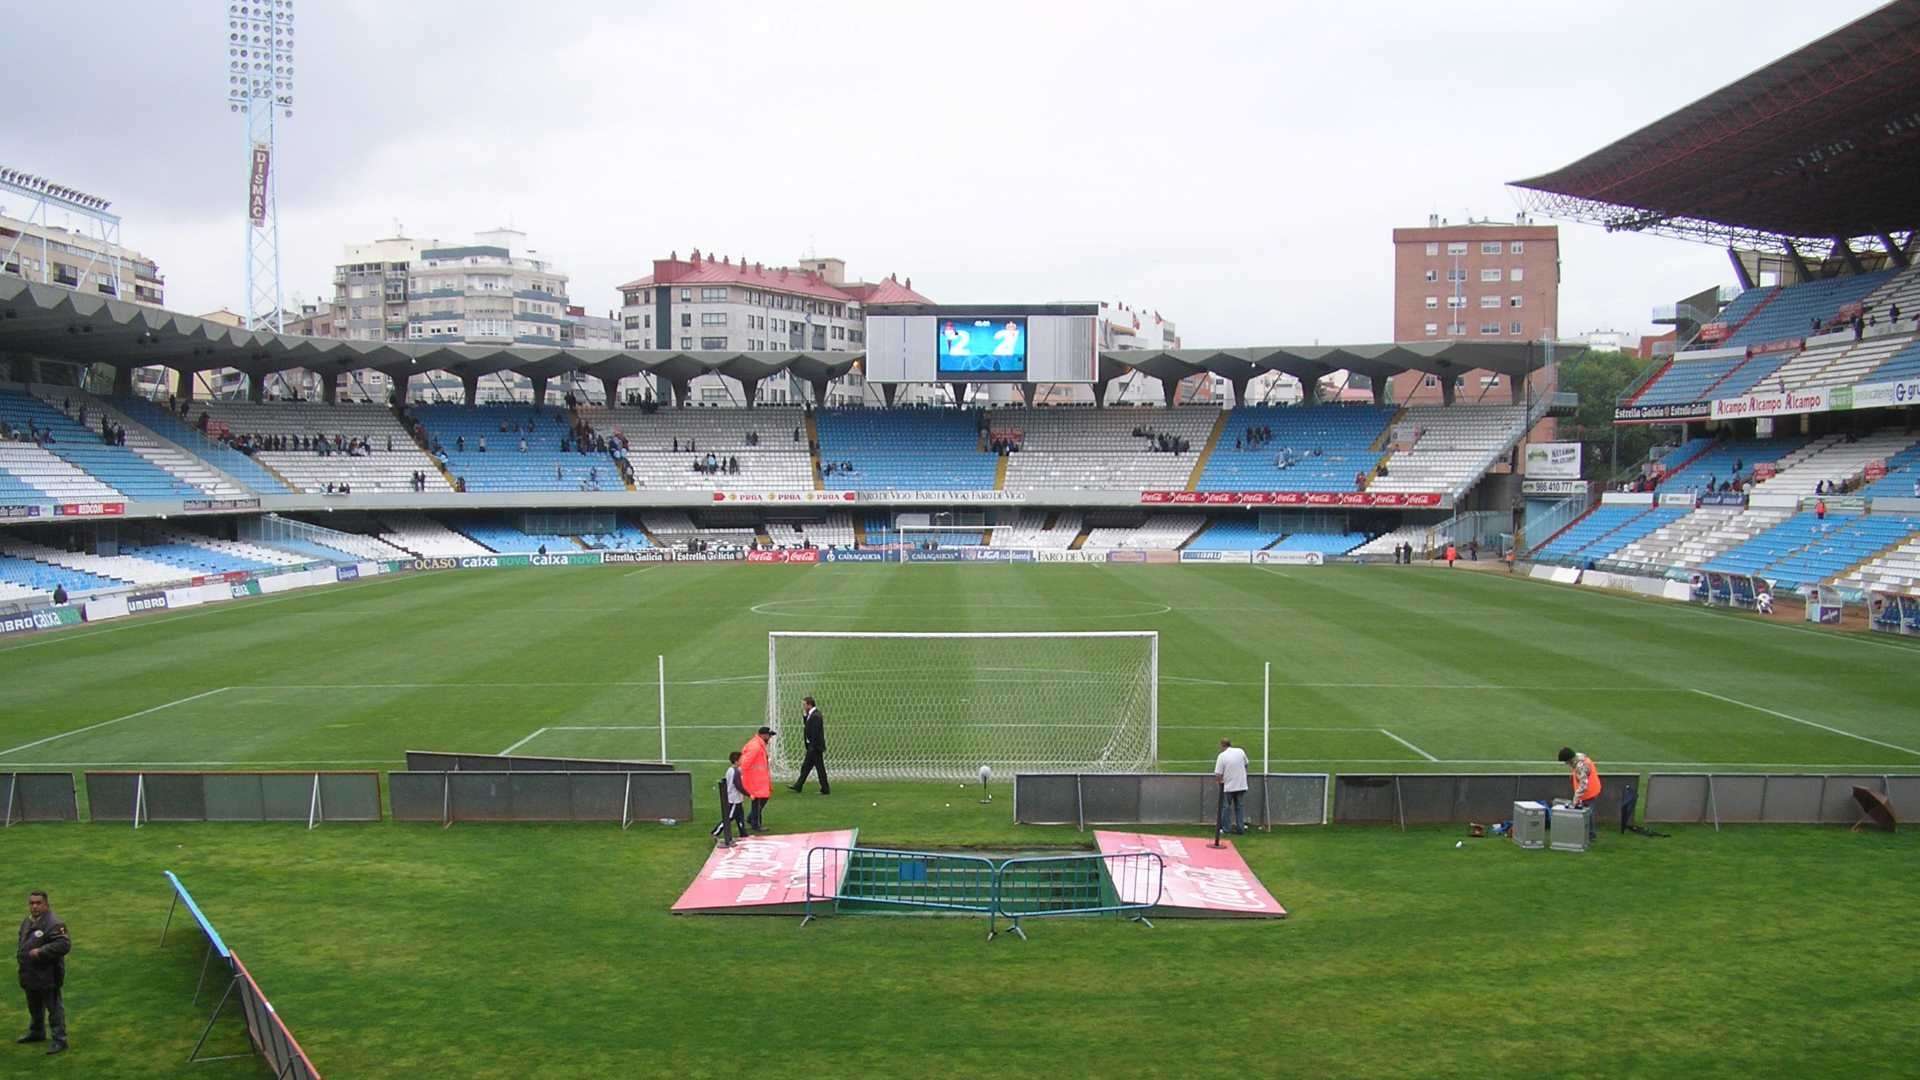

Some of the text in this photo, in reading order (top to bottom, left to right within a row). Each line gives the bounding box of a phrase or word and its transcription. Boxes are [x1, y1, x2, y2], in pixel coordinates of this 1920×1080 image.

[252, 151, 267, 218] DISMAC
[1717, 399, 1748, 416] Alcampo
[1749, 396, 1782, 413] Alcampo
[1785, 392, 1821, 411] Alcampo
[605, 552, 634, 562] Estrella
[635, 552, 662, 562] Galicia
[677, 551, 706, 561] Estrella
[977, 550, 1000, 560] LIGA
[1038, 551, 1064, 562] FARO
[1066, 553, 1079, 561] DE
[1080, 551, 1105, 562] VIGO
[414, 559, 457, 570] OCASO
[128, 597, 166, 612] UMBRO
